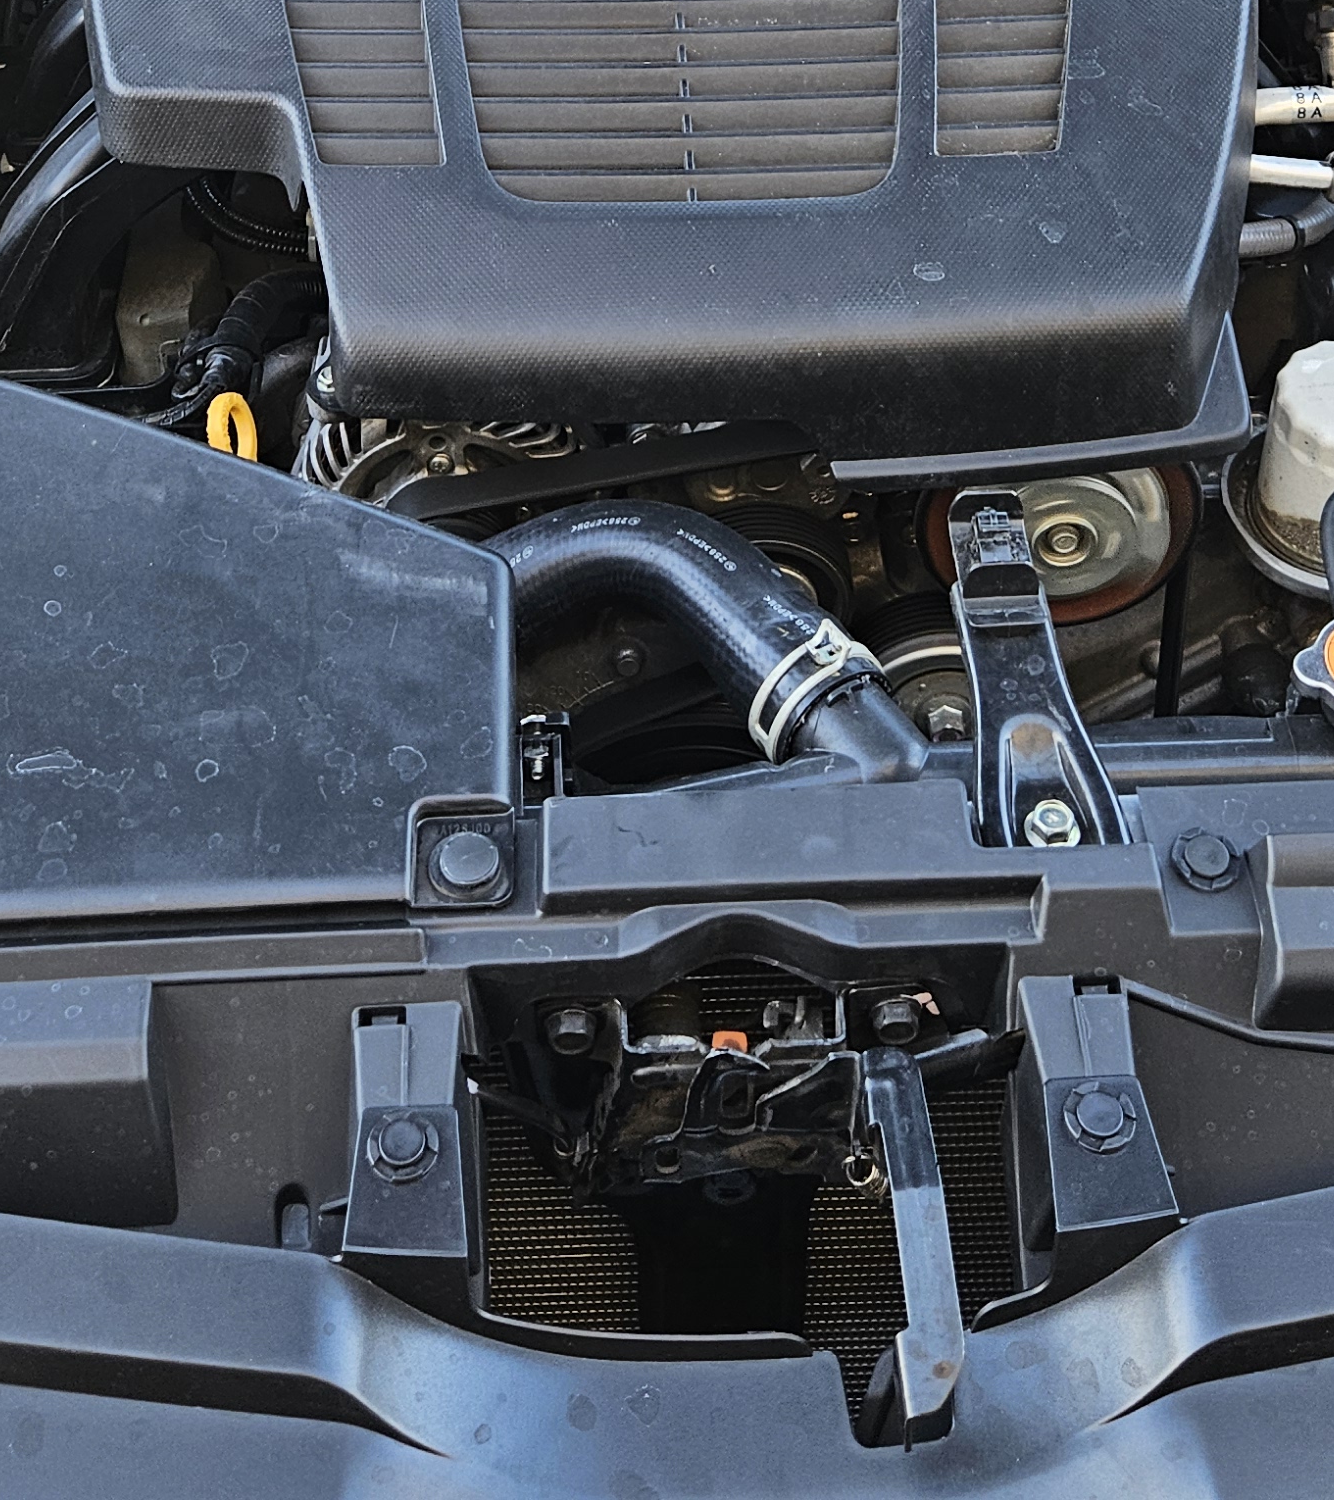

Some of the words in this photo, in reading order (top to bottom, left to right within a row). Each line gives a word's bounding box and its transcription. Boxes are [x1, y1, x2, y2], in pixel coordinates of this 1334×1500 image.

[1296, 92, 1306, 104] 8
[1297, 107, 1306, 119] 8
[1311, 106, 1322, 118] A
